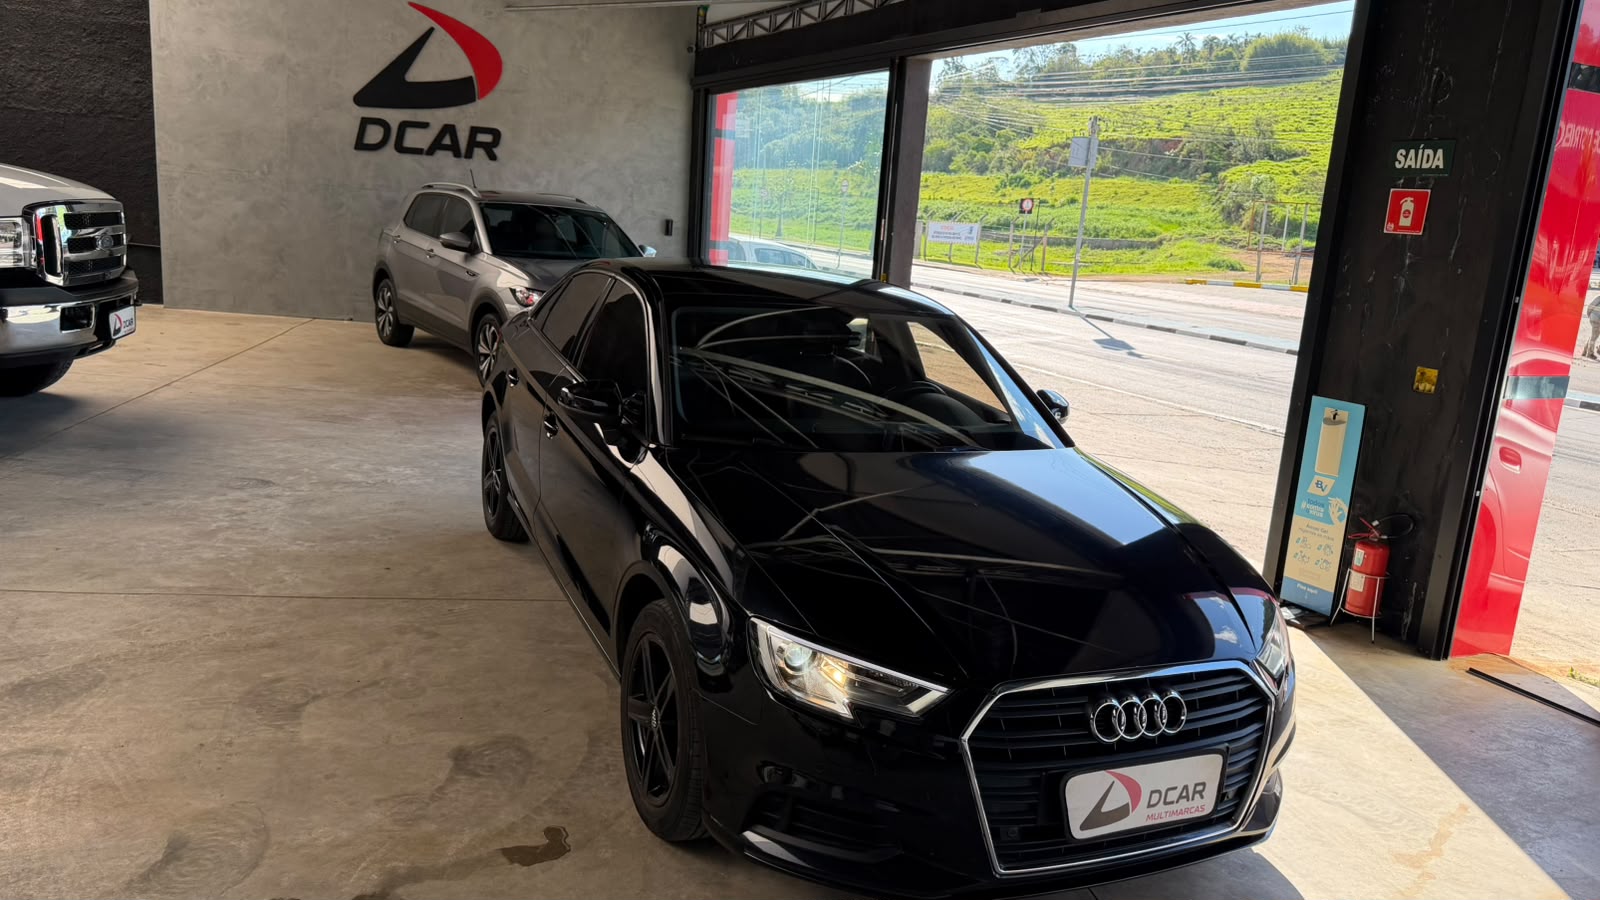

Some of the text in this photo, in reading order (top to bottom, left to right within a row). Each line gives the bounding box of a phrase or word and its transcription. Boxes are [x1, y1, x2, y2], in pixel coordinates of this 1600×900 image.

[354, 116, 502, 161] DCAR
[1395, 144, 1444, 169] SAÍDA
[1147, 782, 1206, 808] DCAR
[1146, 805, 1206, 821] MULTIMARCAS
